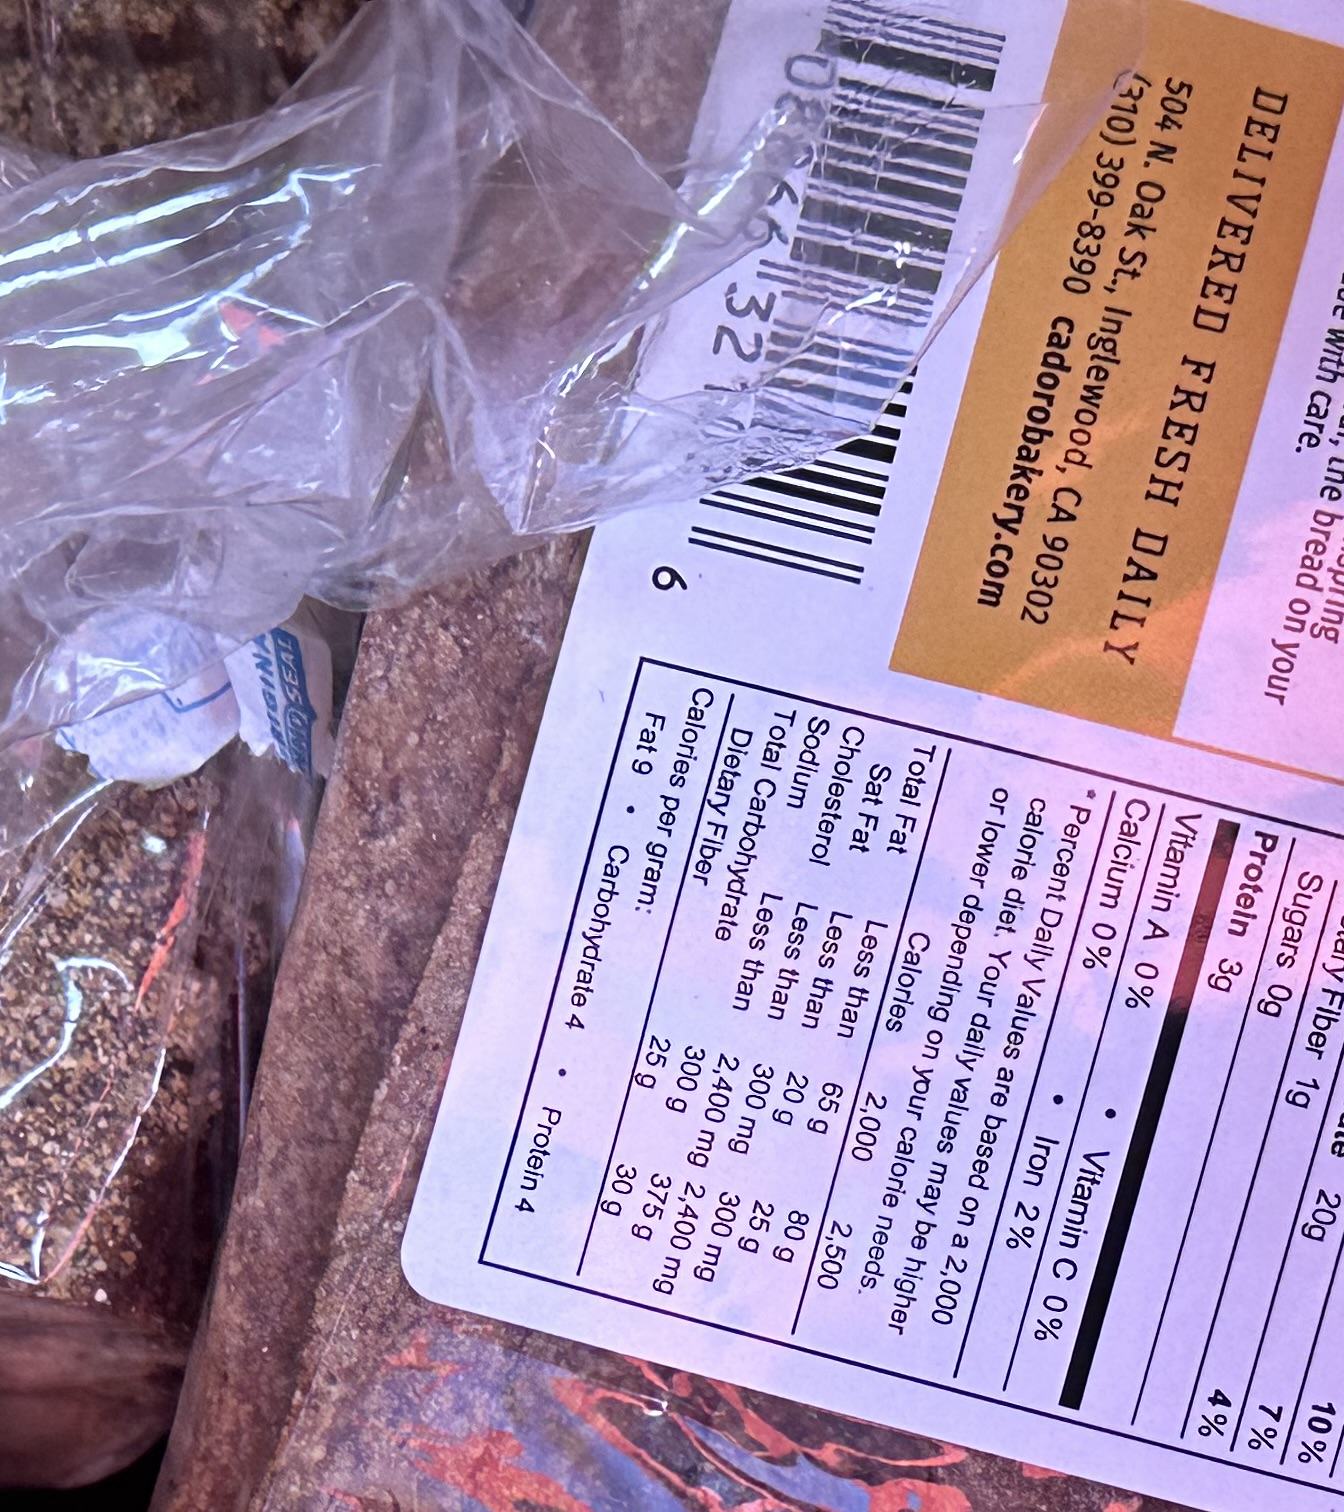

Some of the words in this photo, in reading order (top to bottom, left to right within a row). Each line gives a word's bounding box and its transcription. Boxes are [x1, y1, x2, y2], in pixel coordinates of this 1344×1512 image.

[1098, 68, 1154, 147] (310)
[1153, 75, 1195, 133] 504
[1142, 139, 1179, 169] N.
[1061, 149, 1126, 296] 399-8390
[1123, 179, 1167, 242] Oak
[1191, 84, 1290, 335] DELIVERED
[1101, 245, 1149, 295] St.,
[1054, 304, 1134, 475] Inglewood,
[1294, 388, 1334, 455] care.
[976, 314, 1076, 609] cadorobakery.com
[1143, 353, 1218, 509] FRESH
[1045, 485, 1084, 524] CA
[653, 564, 688, 592] 6
[1019, 532, 1071, 627] 90302
[1294, 508, 1344, 594] bread
[1101, 525, 1170, 666] DAILY
[1282, 596, 1312, 635] on
[277, 636, 304, 704] SEAL
[1263, 636, 1302, 707] your
[785, 715, 832, 811] Sodium
[1009, 796, 1048, 882] calorie
[1097, 797, 1152, 911] Calcium
[1149, 812, 1204, 914] Vitamin
[991, 886, 1027, 939] diet.
[1226, 829, 1281, 939] Protein
[569, 843, 631, 1009] Carbohydrate
[747, 890, 785, 952] Less
[1141, 917, 1171, 942] A
[1274, 869, 1325, 970] Sugars
[731, 958, 766, 1013] than
[884, 931, 932, 1034] Calories
[975, 949, 1014, 1010] Your
[1206, 956, 1245, 995] 3g
[1255, 982, 1294, 1019] 0g
[563, 1012, 586, 1031] 4
[953, 1011, 993, 1074] daily
[850, 1090, 889, 1163] 2,000
[935, 1076, 973, 1156] values
[914, 1159, 949, 1218] may
[1021, 1134, 1062, 1188] Iron
[909, 1218, 939, 1252] be
[1299, 1187, 1343, 1244] 20g
[815, 1218, 854, 1291] 2,500
[887, 1255, 929, 1337] higher
